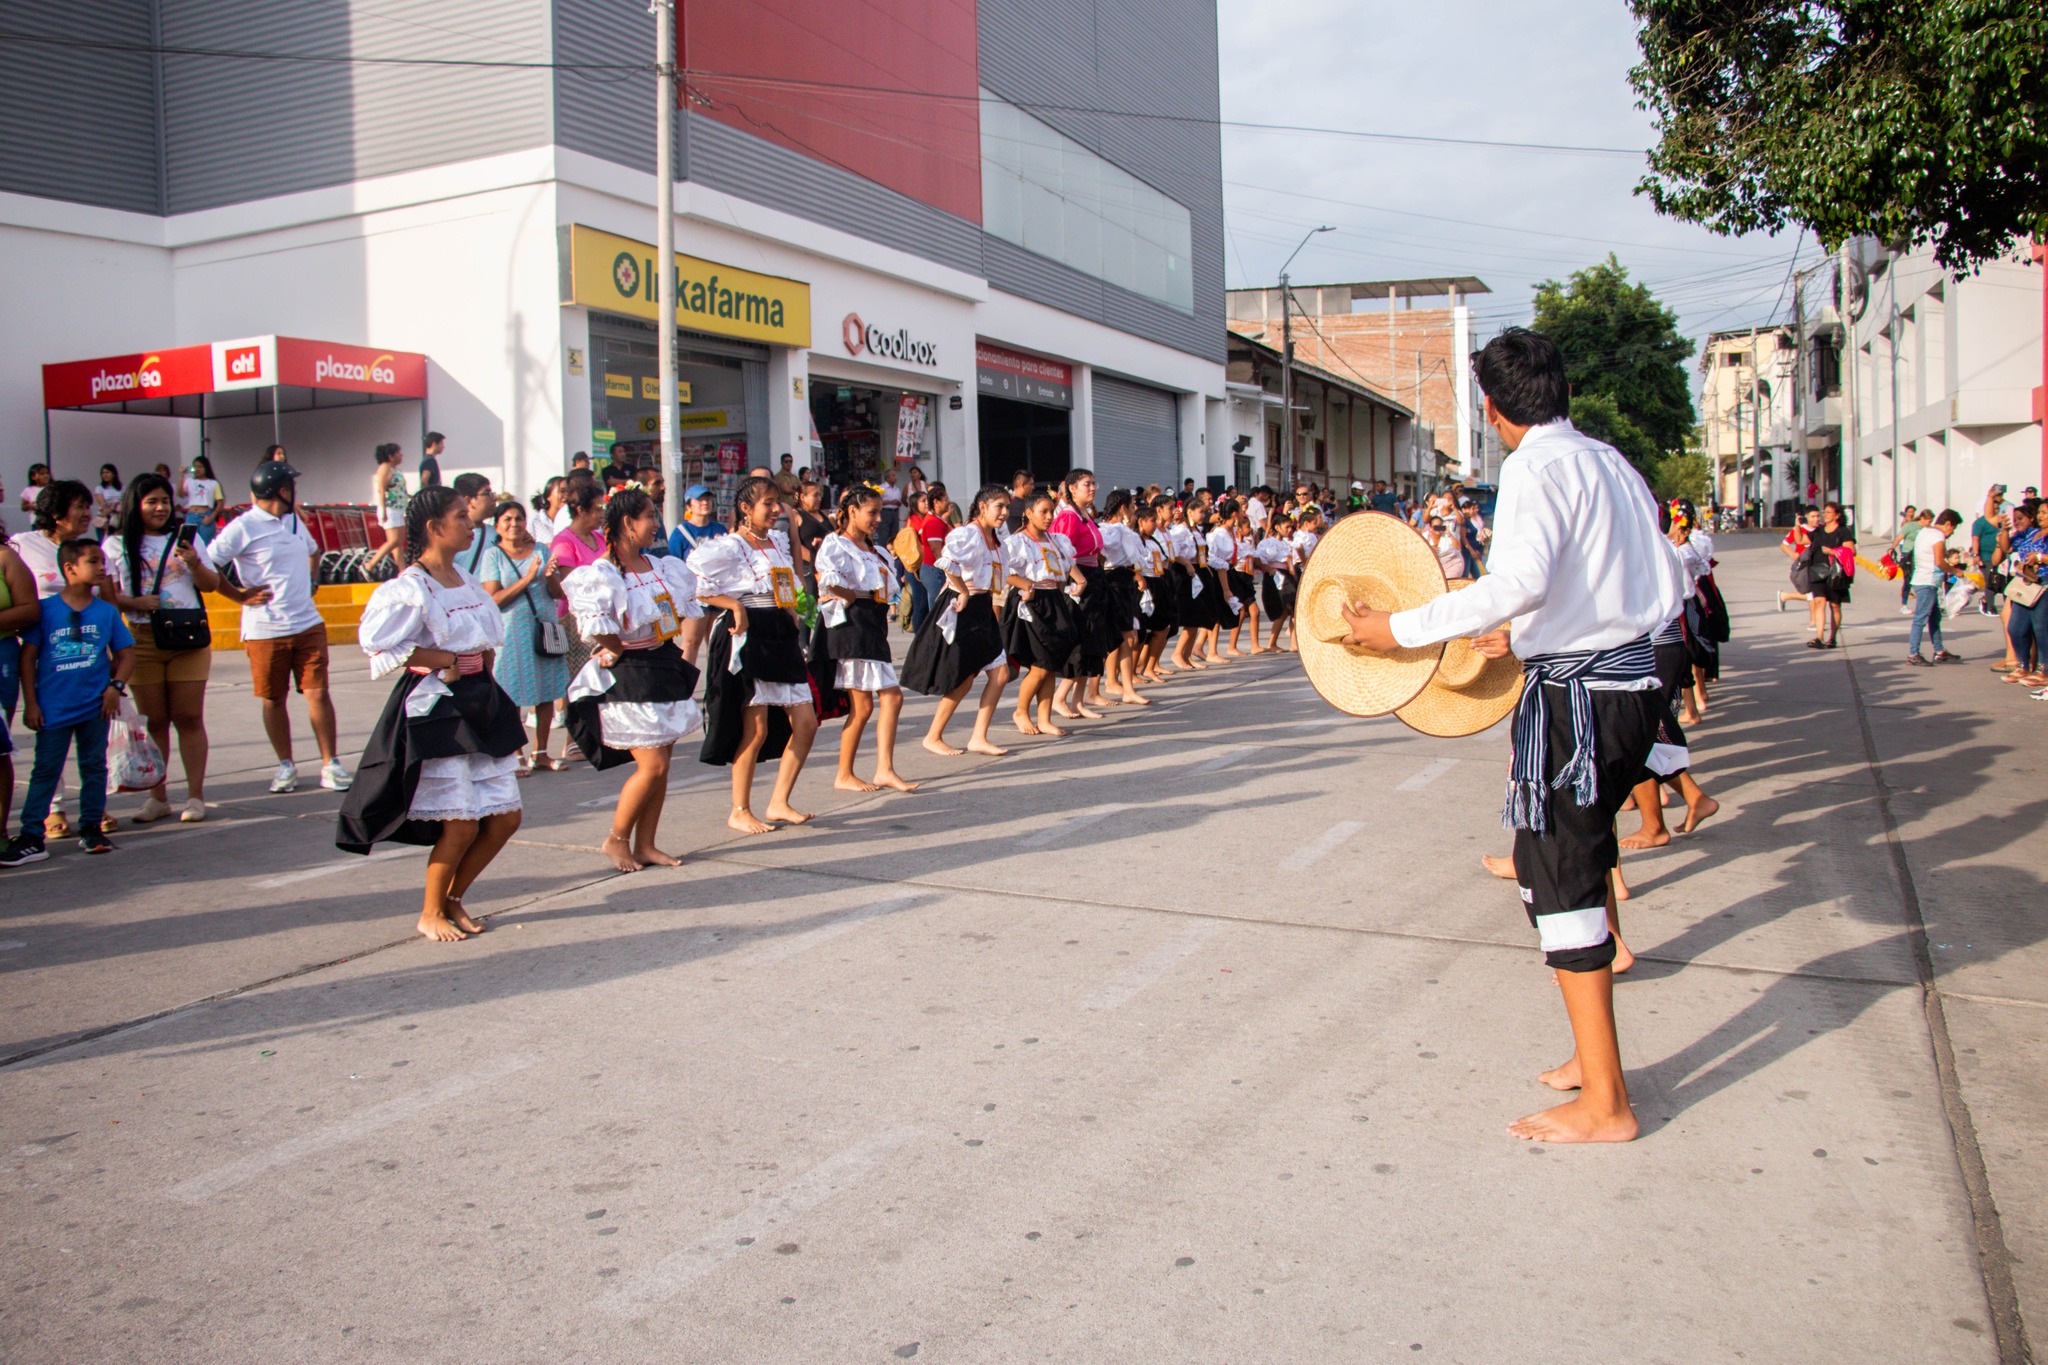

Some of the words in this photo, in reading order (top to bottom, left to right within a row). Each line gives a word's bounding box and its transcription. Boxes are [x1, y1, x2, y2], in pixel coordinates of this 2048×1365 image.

[232, 353, 255, 374] oh!
[1022, 359, 1040, 373] para
[1039, 364, 1064, 379] clientes
[605, 379, 631, 392] farma
[979, 375, 993, 386] Salida
[1038, 386, 1055, 398] Entrada
